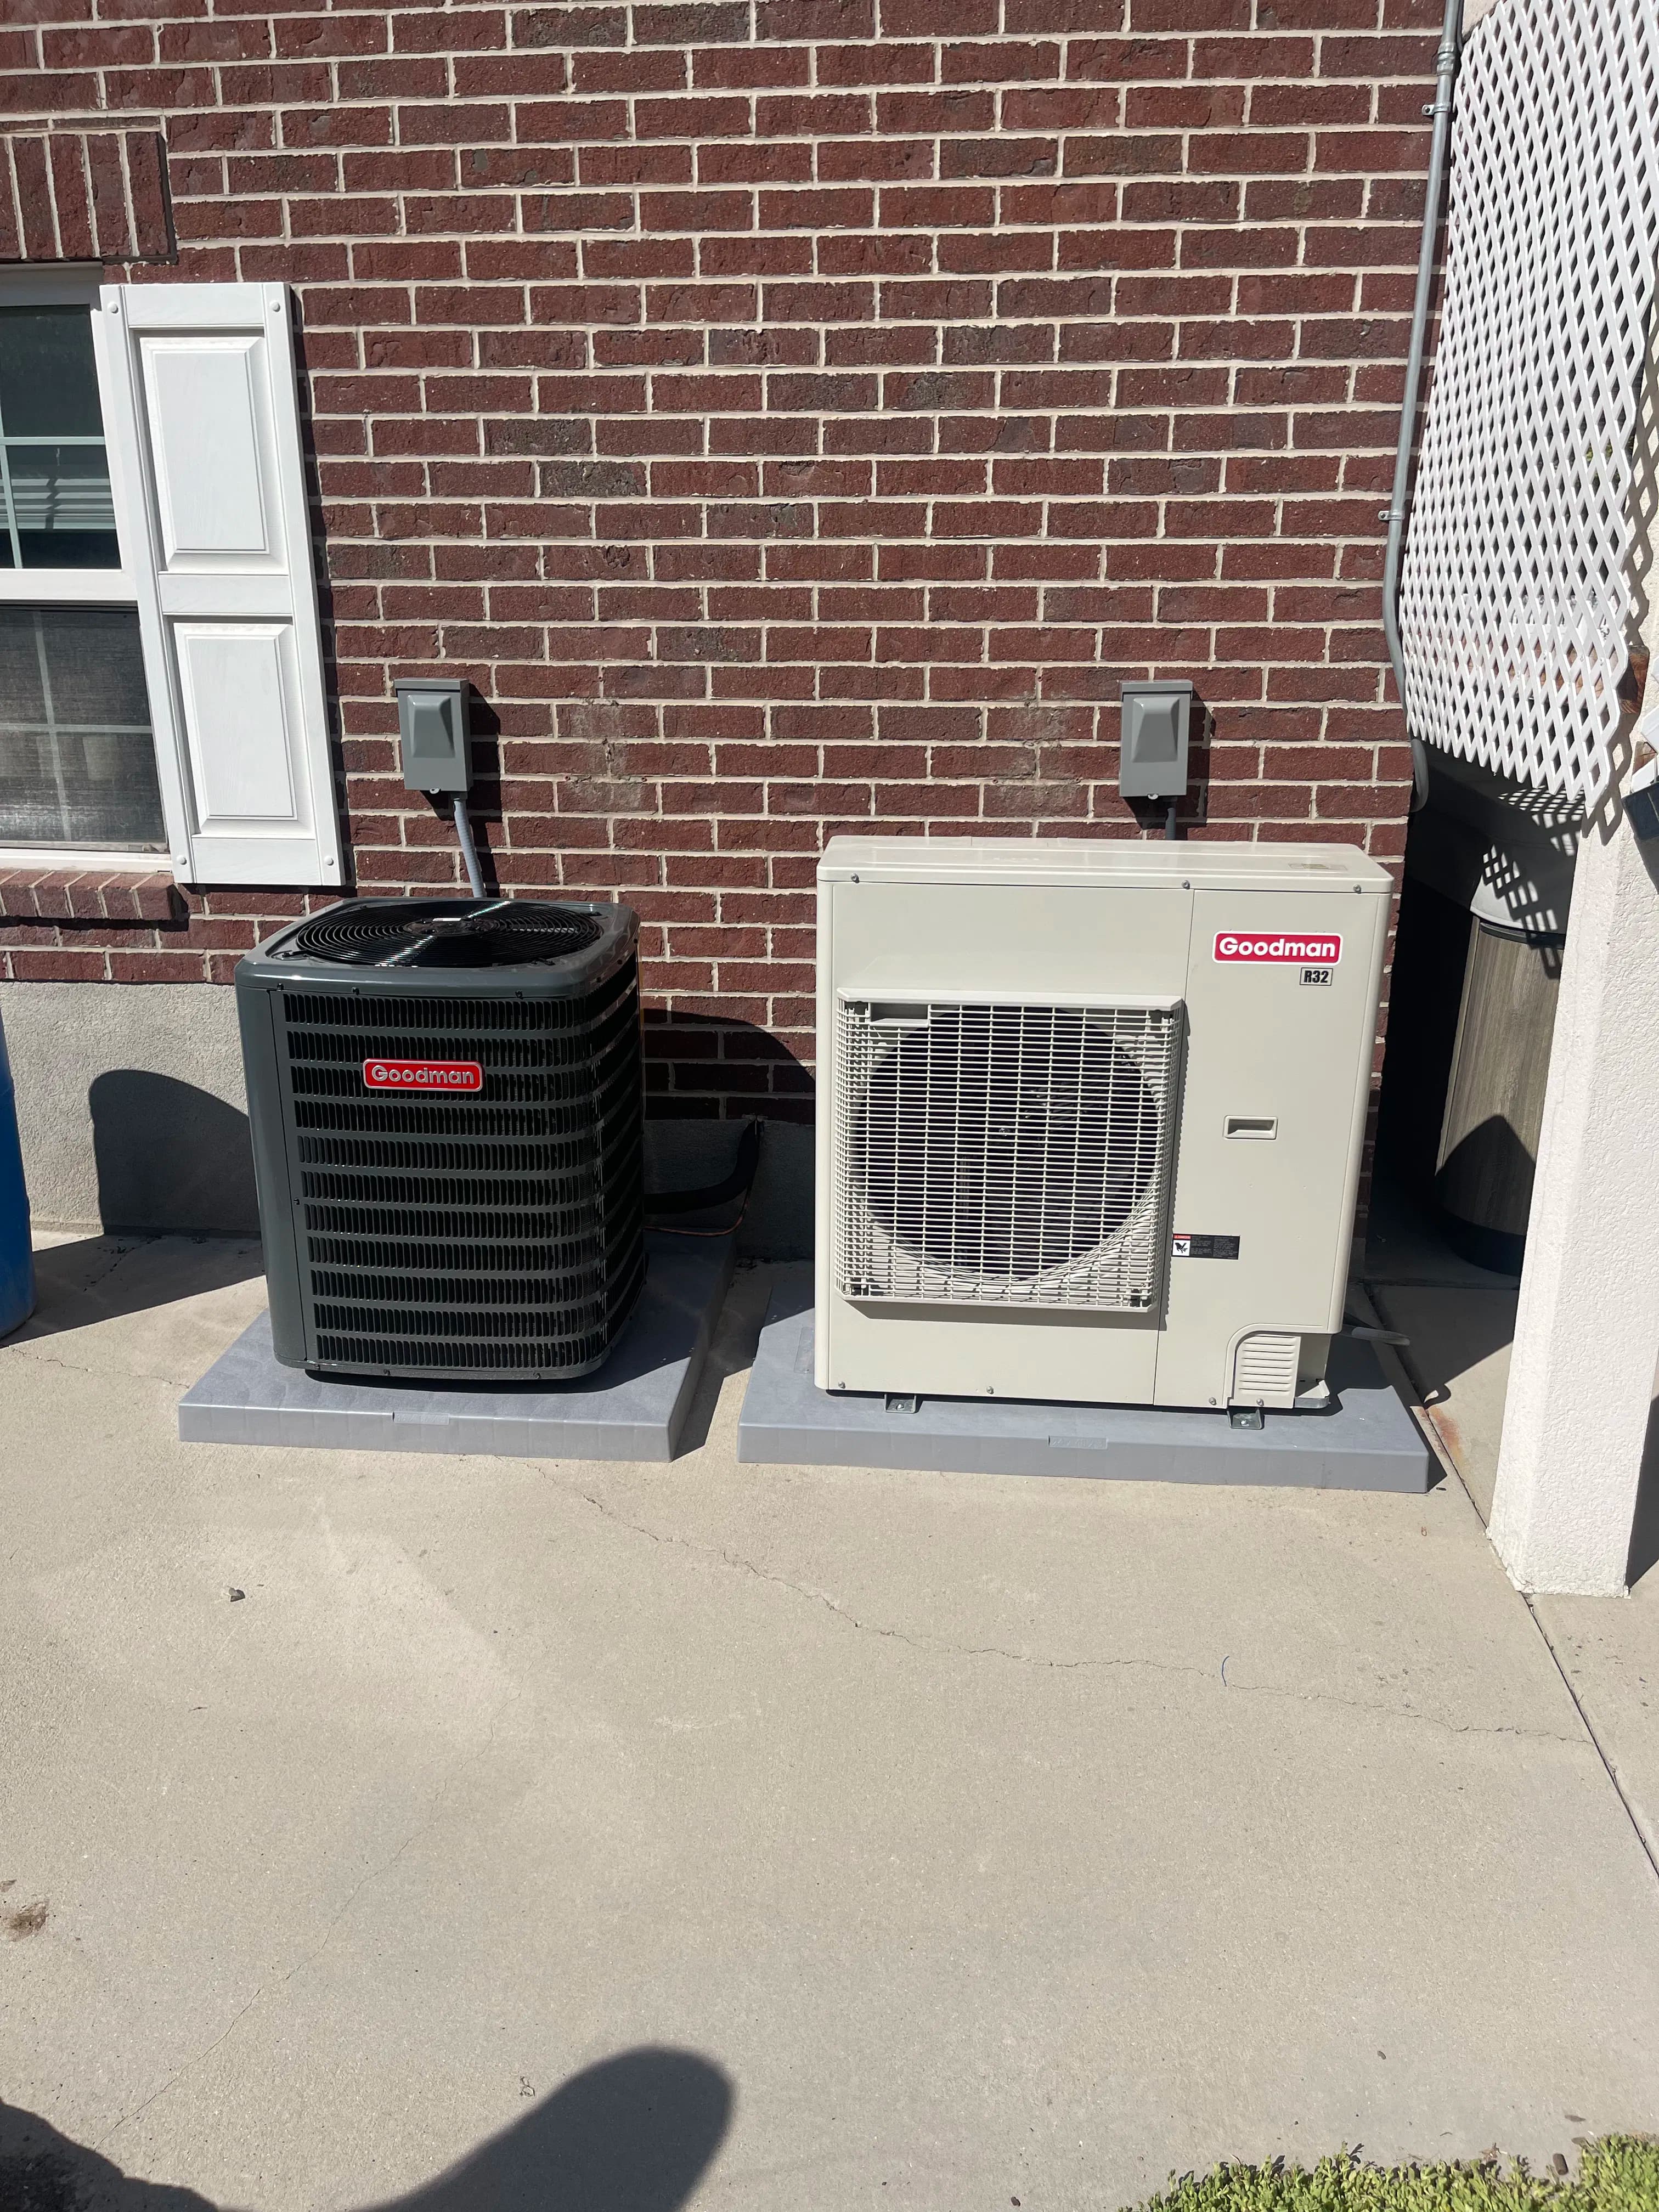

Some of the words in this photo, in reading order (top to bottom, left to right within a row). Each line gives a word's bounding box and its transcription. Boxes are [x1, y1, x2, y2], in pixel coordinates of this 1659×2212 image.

[1219, 937, 1336, 957] Goodman
[1304, 970, 1329, 983] R32
[371, 1065, 475, 1085] Goodman
